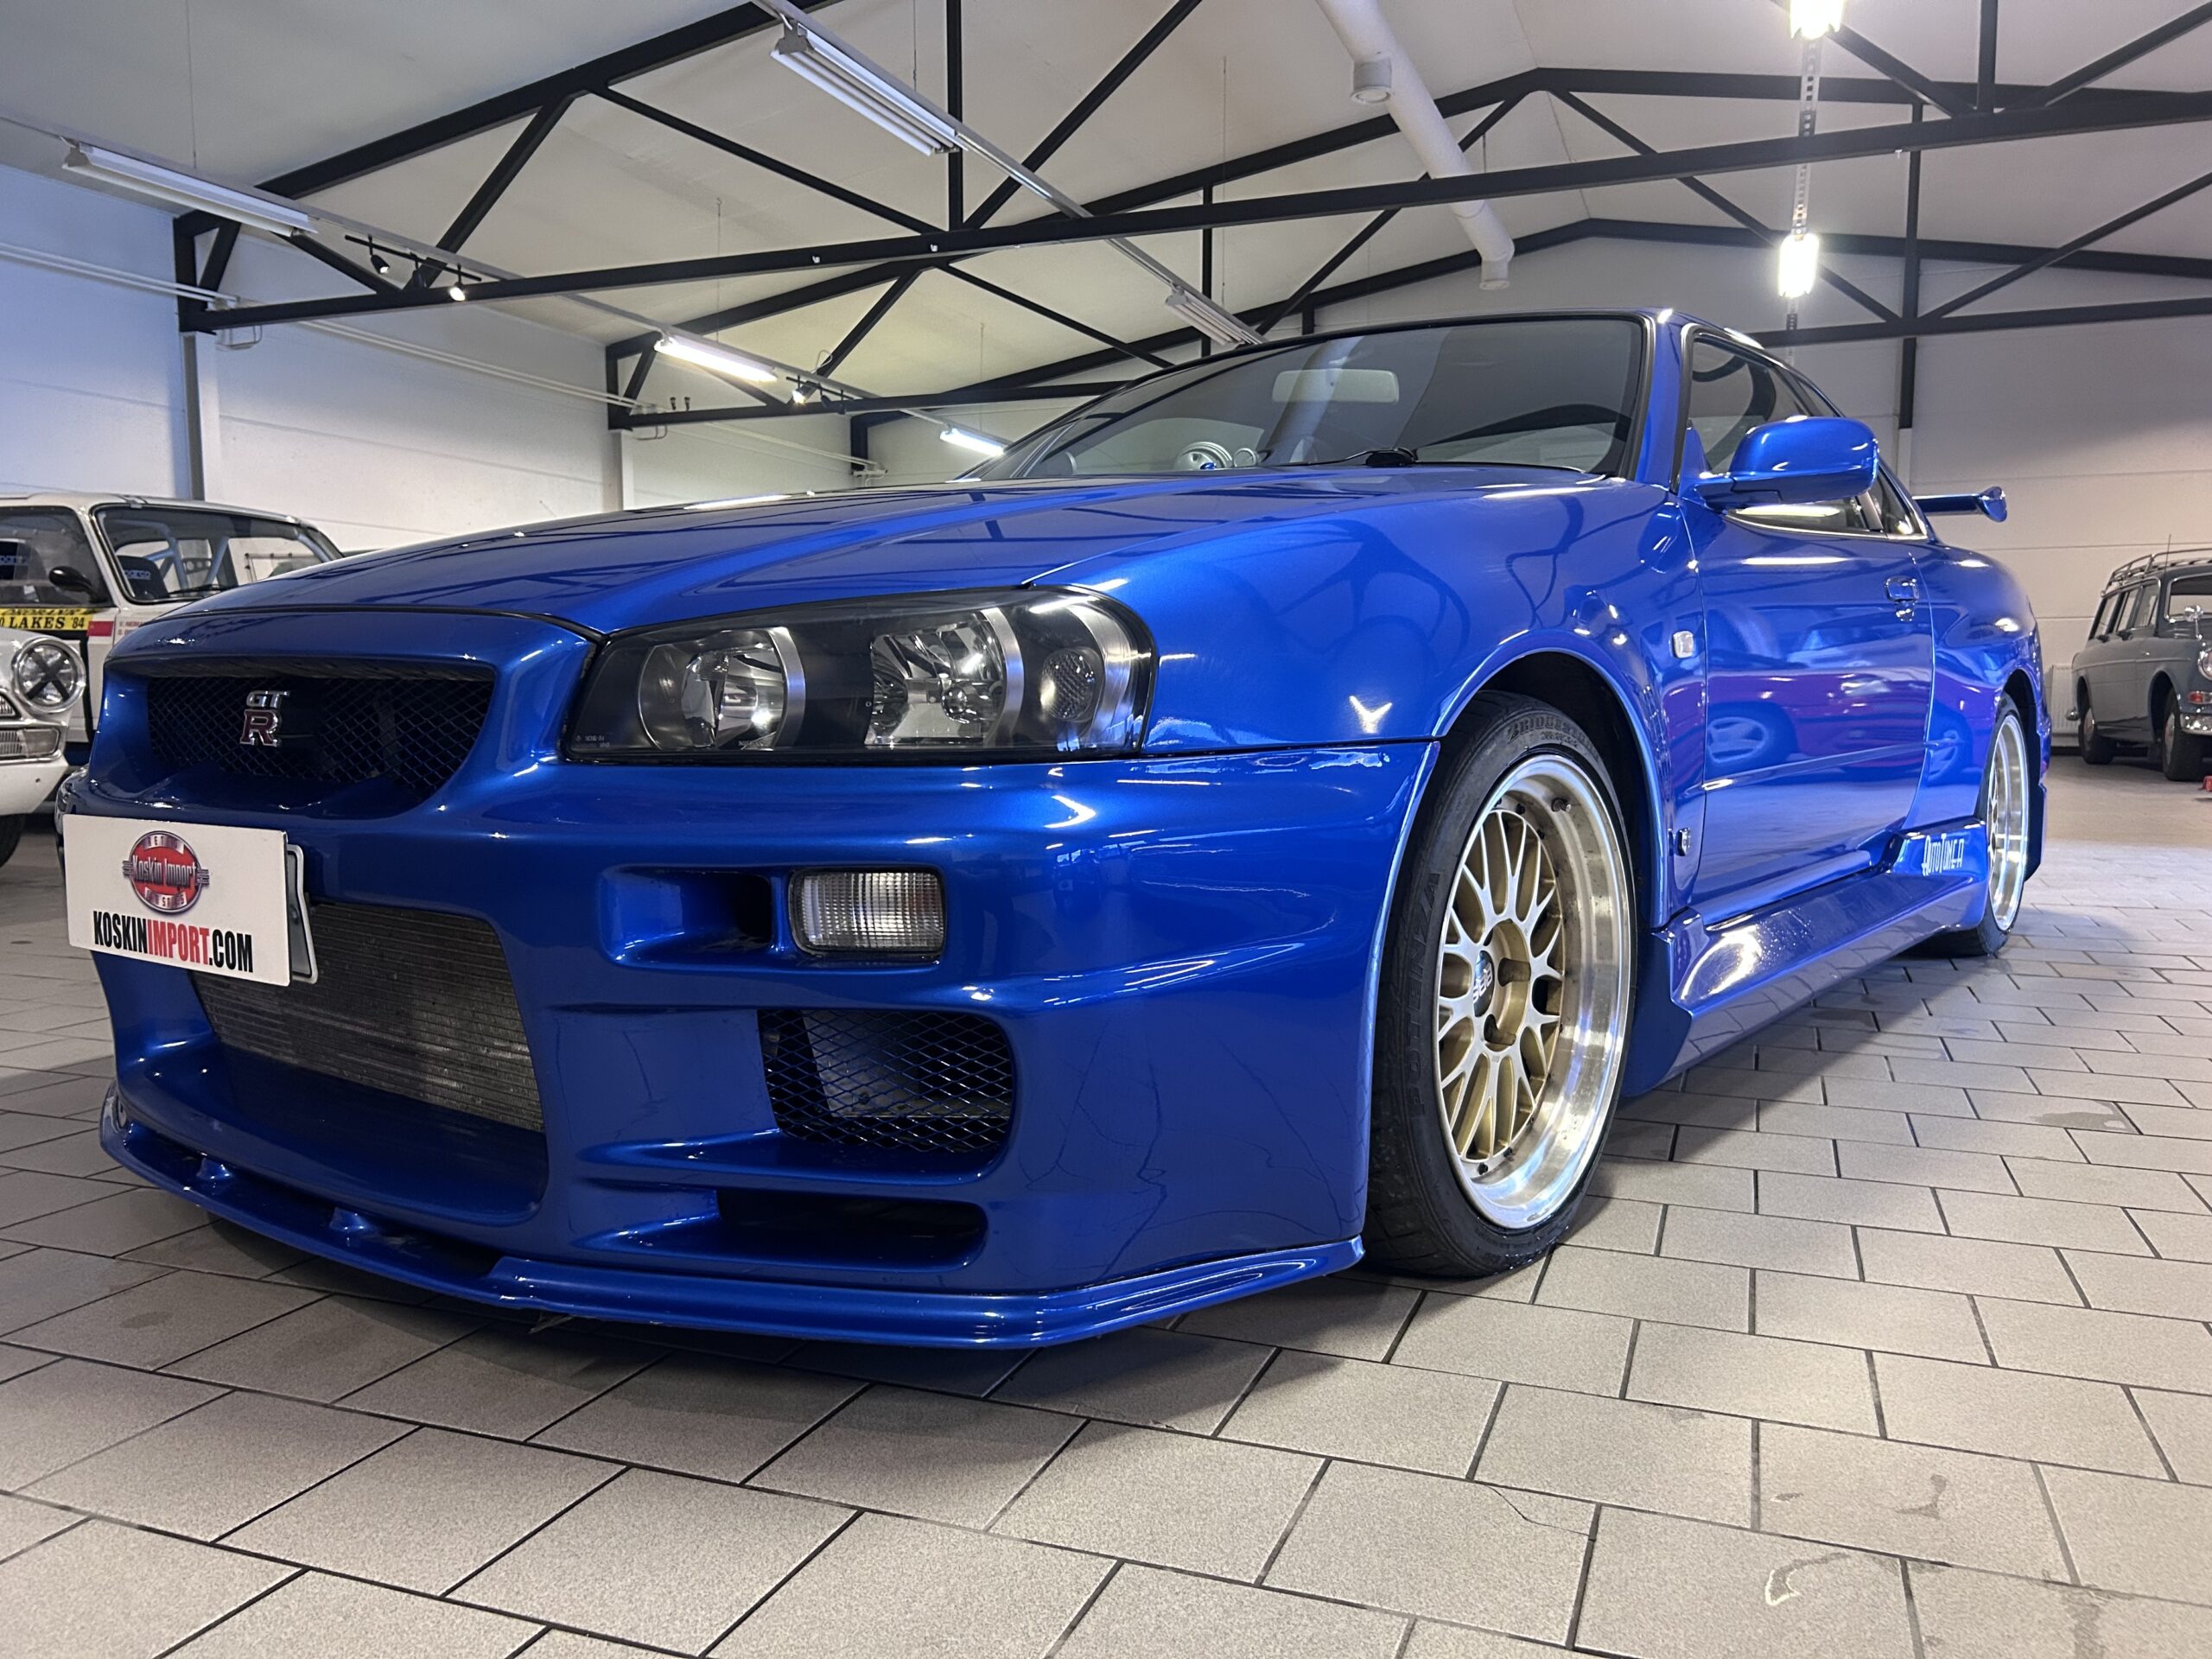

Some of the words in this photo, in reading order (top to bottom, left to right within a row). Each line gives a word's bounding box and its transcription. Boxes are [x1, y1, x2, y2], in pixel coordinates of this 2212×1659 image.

[9, 616, 66, 629] LAKES
[71, 616, 85, 628] '84
[246, 690, 291, 709] GT
[239, 709, 281, 748] R
[132, 855, 162, 884] Koskin
[163, 858, 197, 887] Import
[93, 910, 254, 973] KOSKINIMPORT.COM
[1408, 872, 1441, 1113] POTENZA
[1472, 962, 1493, 1003] BBS
